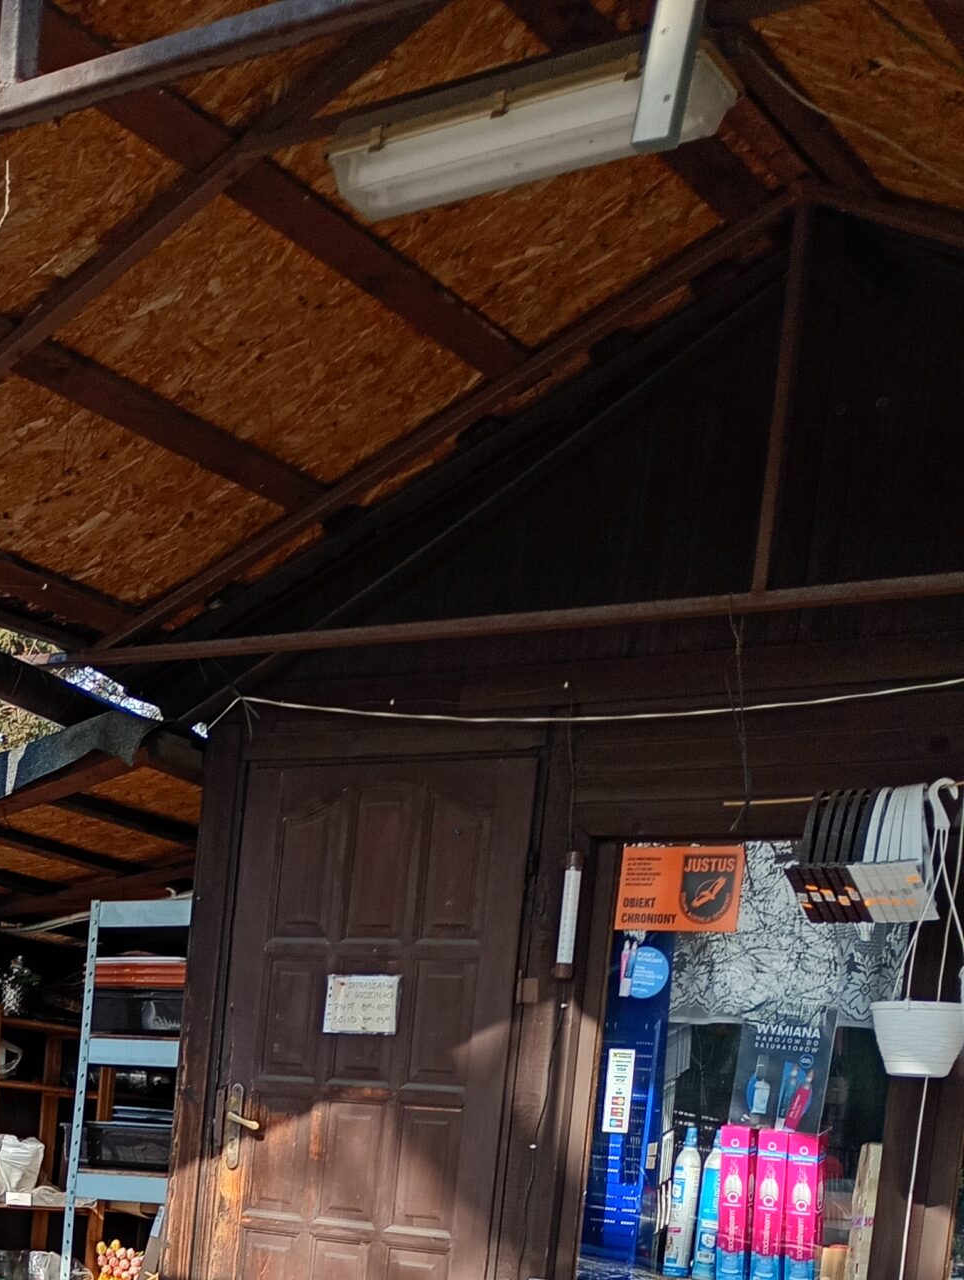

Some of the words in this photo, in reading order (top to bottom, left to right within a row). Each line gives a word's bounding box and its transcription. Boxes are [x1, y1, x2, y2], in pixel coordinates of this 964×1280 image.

[684, 858, 735, 872] JUSTUS
[623, 897, 656, 908] OBIEKT
[621, 913, 676, 924] CHRONIONY
[756, 1024, 820, 1039] WYMIANA
[727, 1210, 736, 1252] sodastream
[762, 1214, 771, 1254] sodastream
[796, 1218, 804, 1259] sodastream
